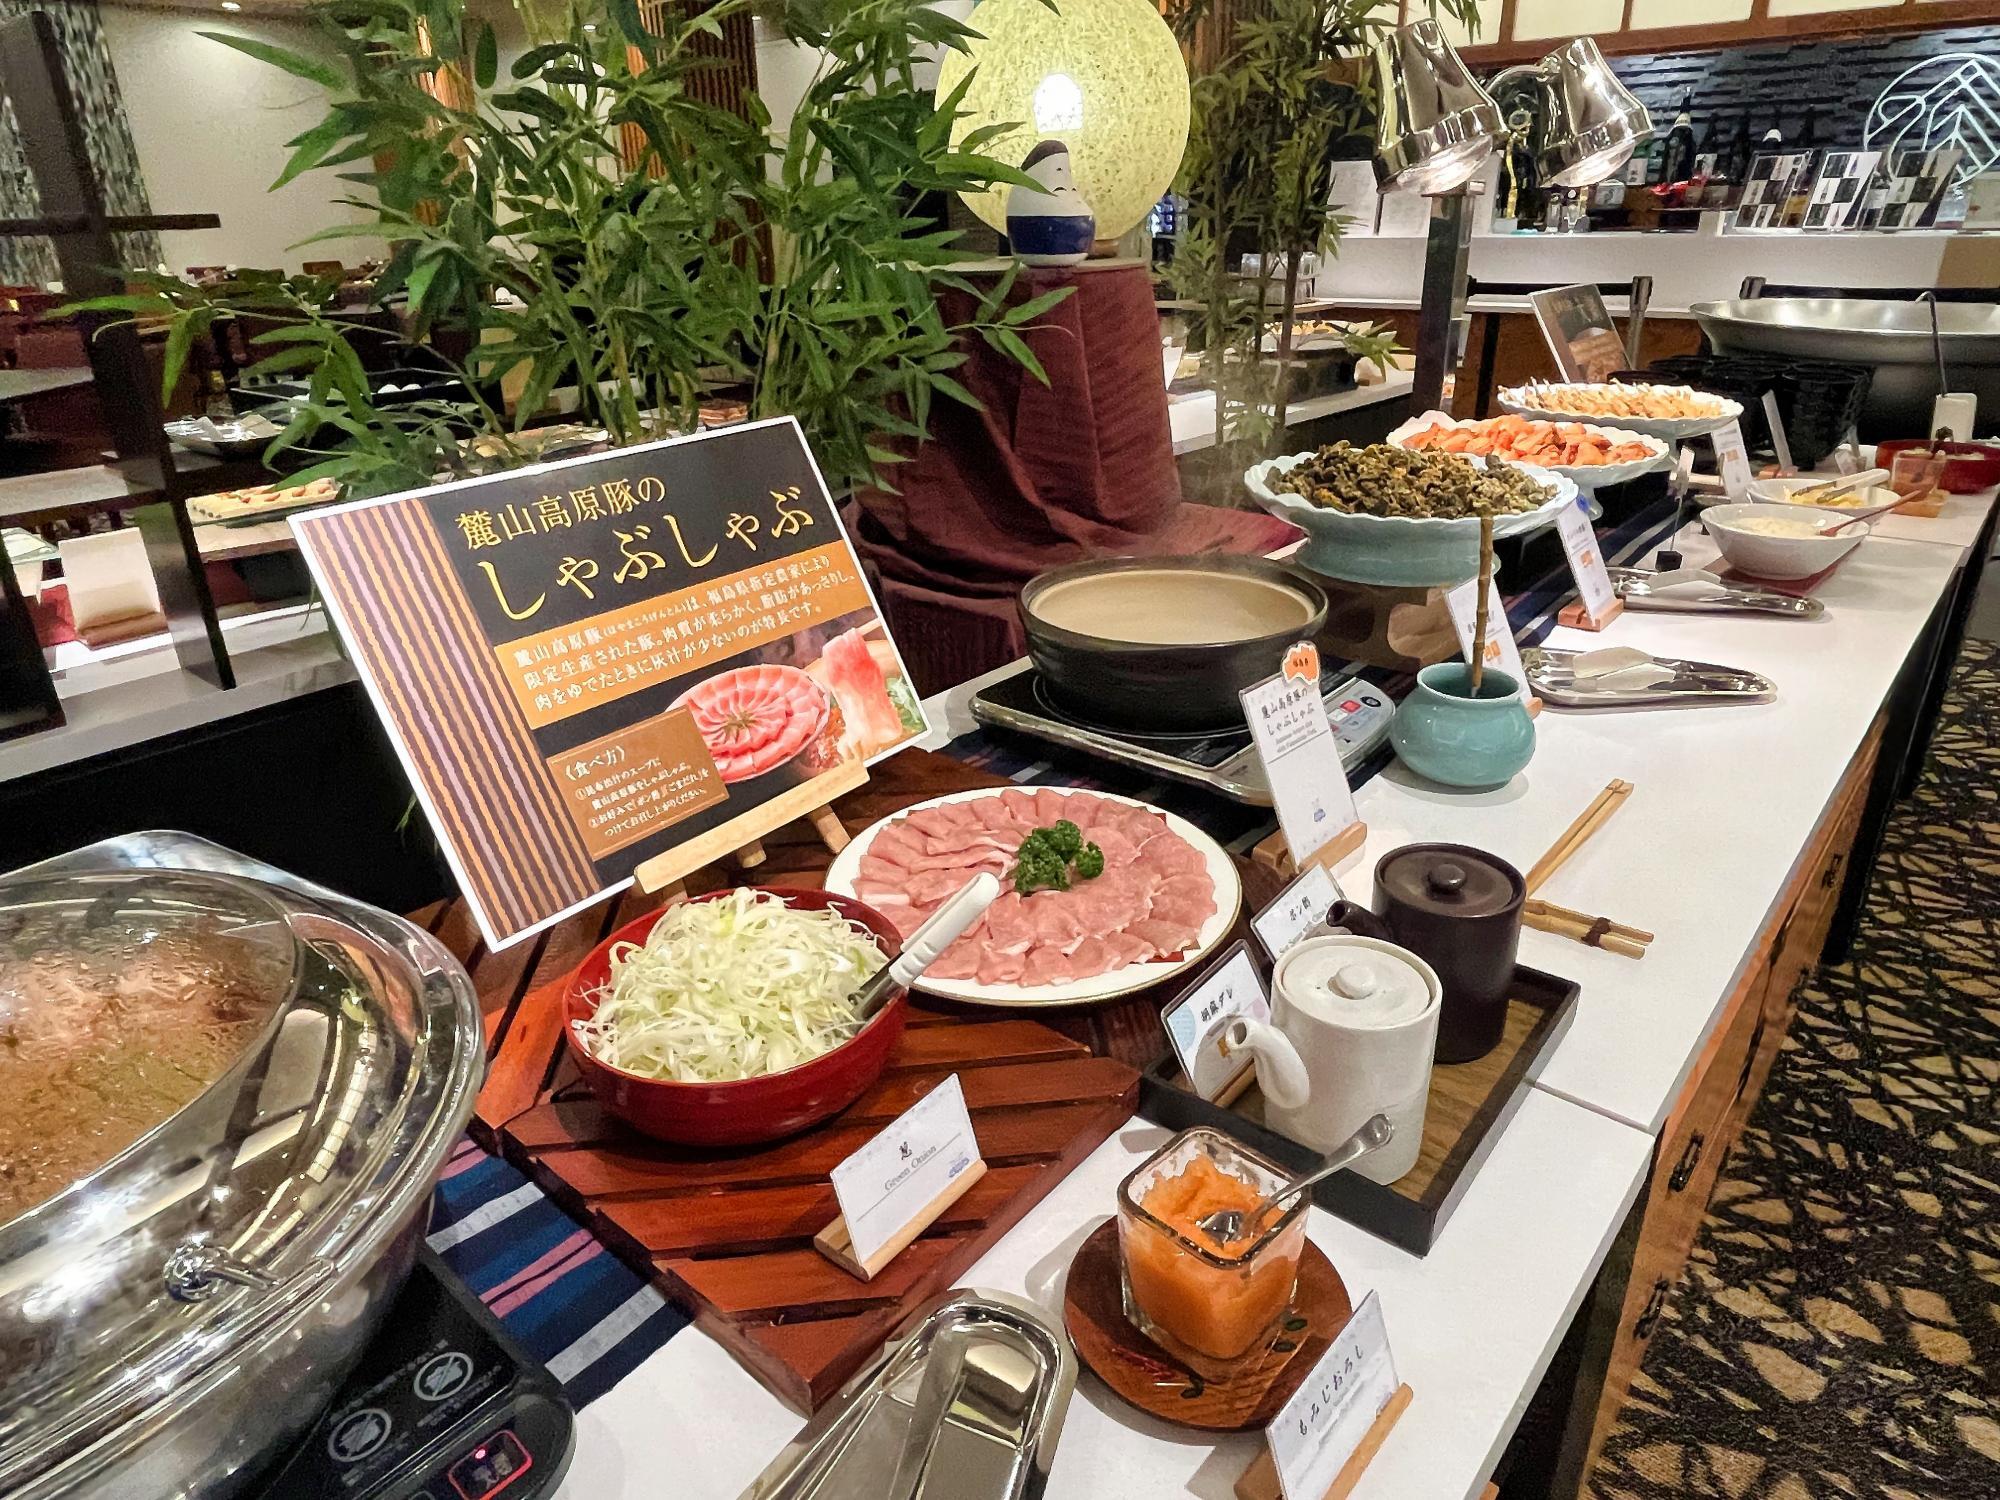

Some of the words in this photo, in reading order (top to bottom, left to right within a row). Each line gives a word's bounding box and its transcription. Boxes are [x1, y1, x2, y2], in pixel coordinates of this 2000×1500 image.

[455, 476, 666, 550] 麓山高原豚の
[477, 486, 815, 621] しゃぶしゃぶ
